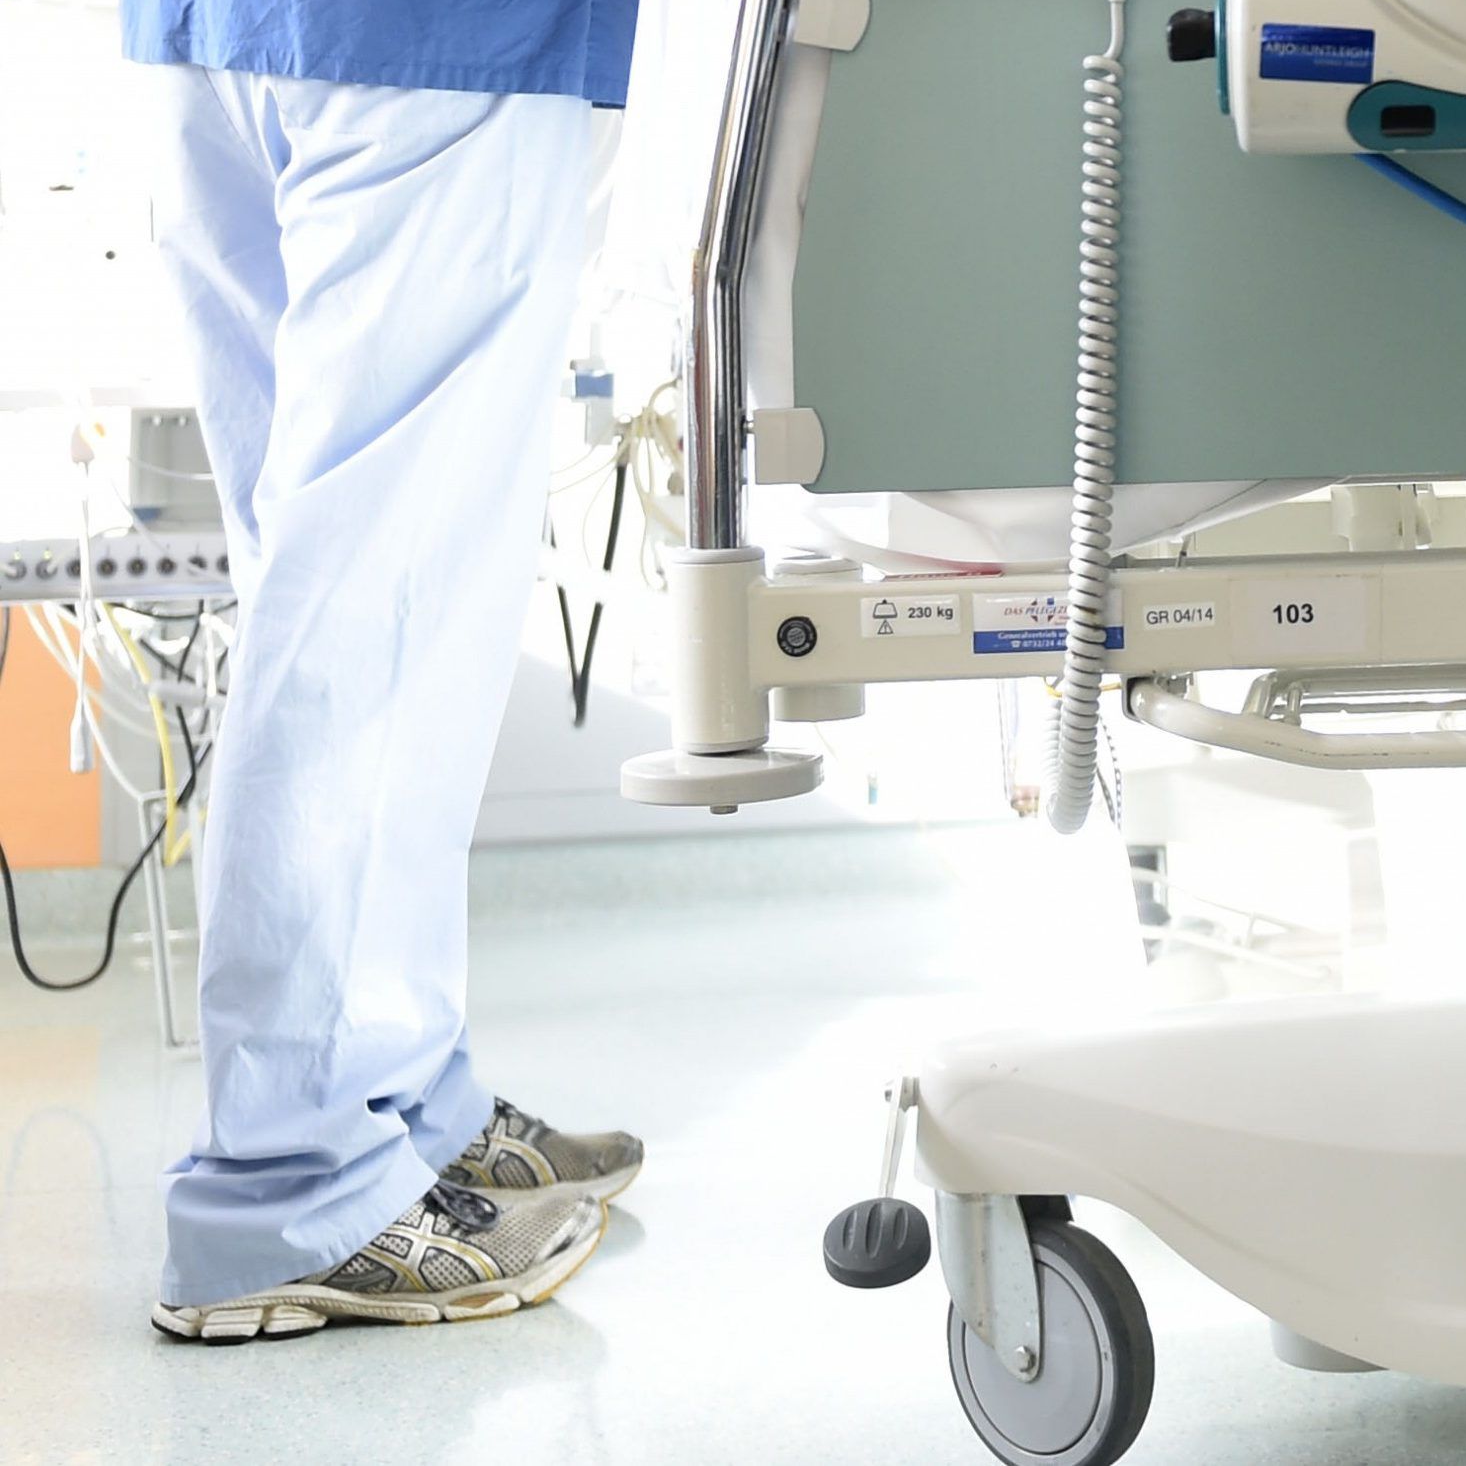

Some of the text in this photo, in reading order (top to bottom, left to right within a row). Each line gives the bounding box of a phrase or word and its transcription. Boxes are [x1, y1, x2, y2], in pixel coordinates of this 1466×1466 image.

[908, 606, 954, 620] 230 kg
[1004, 607, 1023, 615] DAS
[1146, 608, 1213, 624] GR 04/14
[1273, 603, 1314, 624] 103
